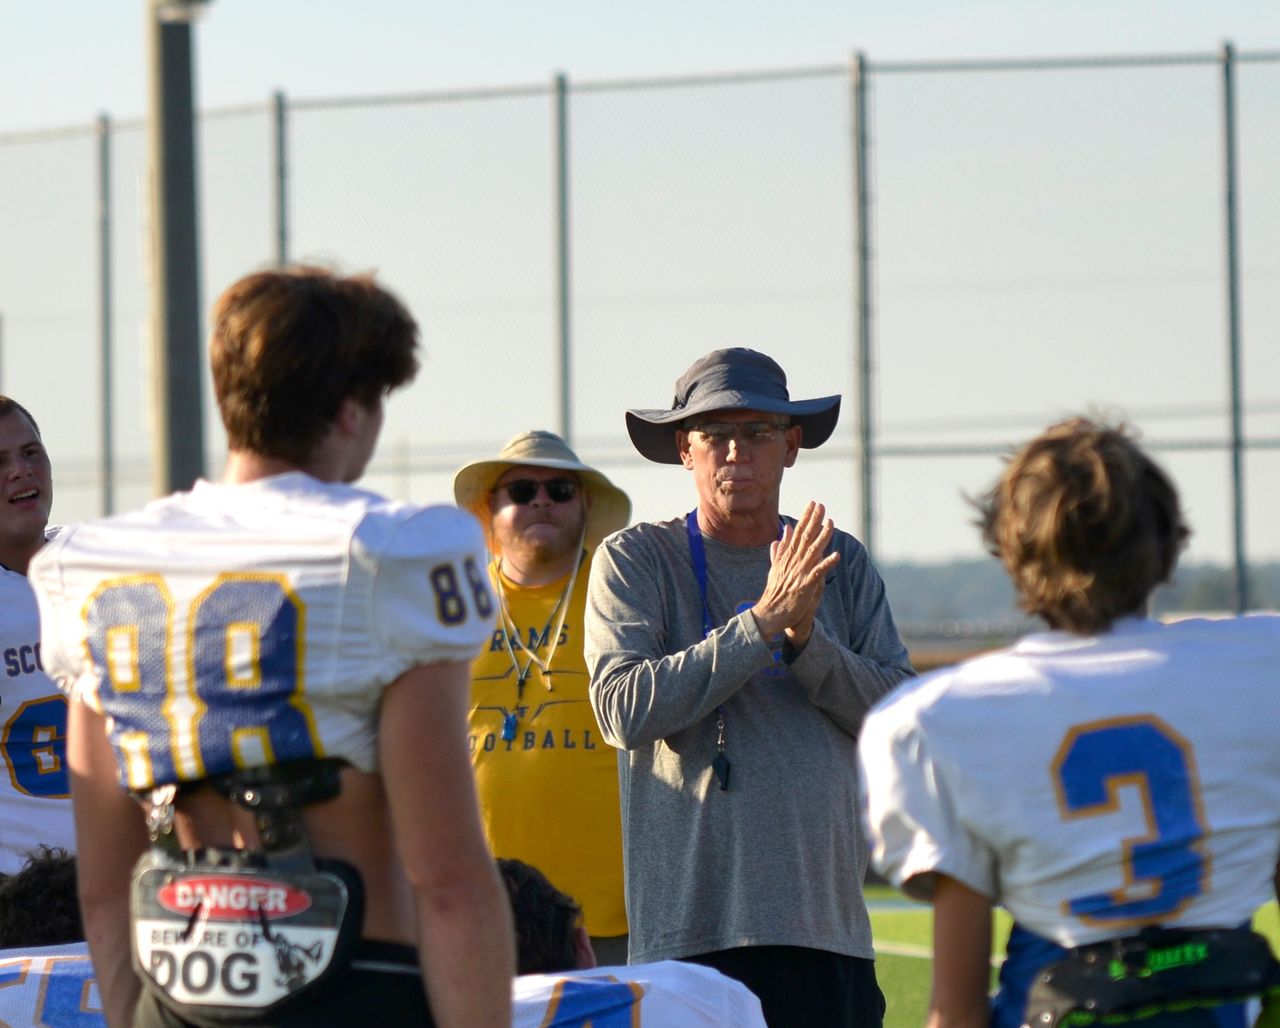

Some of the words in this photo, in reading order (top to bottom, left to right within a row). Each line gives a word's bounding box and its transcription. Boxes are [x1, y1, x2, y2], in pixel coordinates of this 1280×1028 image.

[429, 558, 494, 627] 88
[489, 623, 569, 653] RAMS
[83, 570, 324, 792] 88
[1051, 714, 1213, 928] 3
[174, 883, 288, 912] DANGER
[151, 929, 228, 948] BEWRE
[150, 950, 259, 996] DOG
